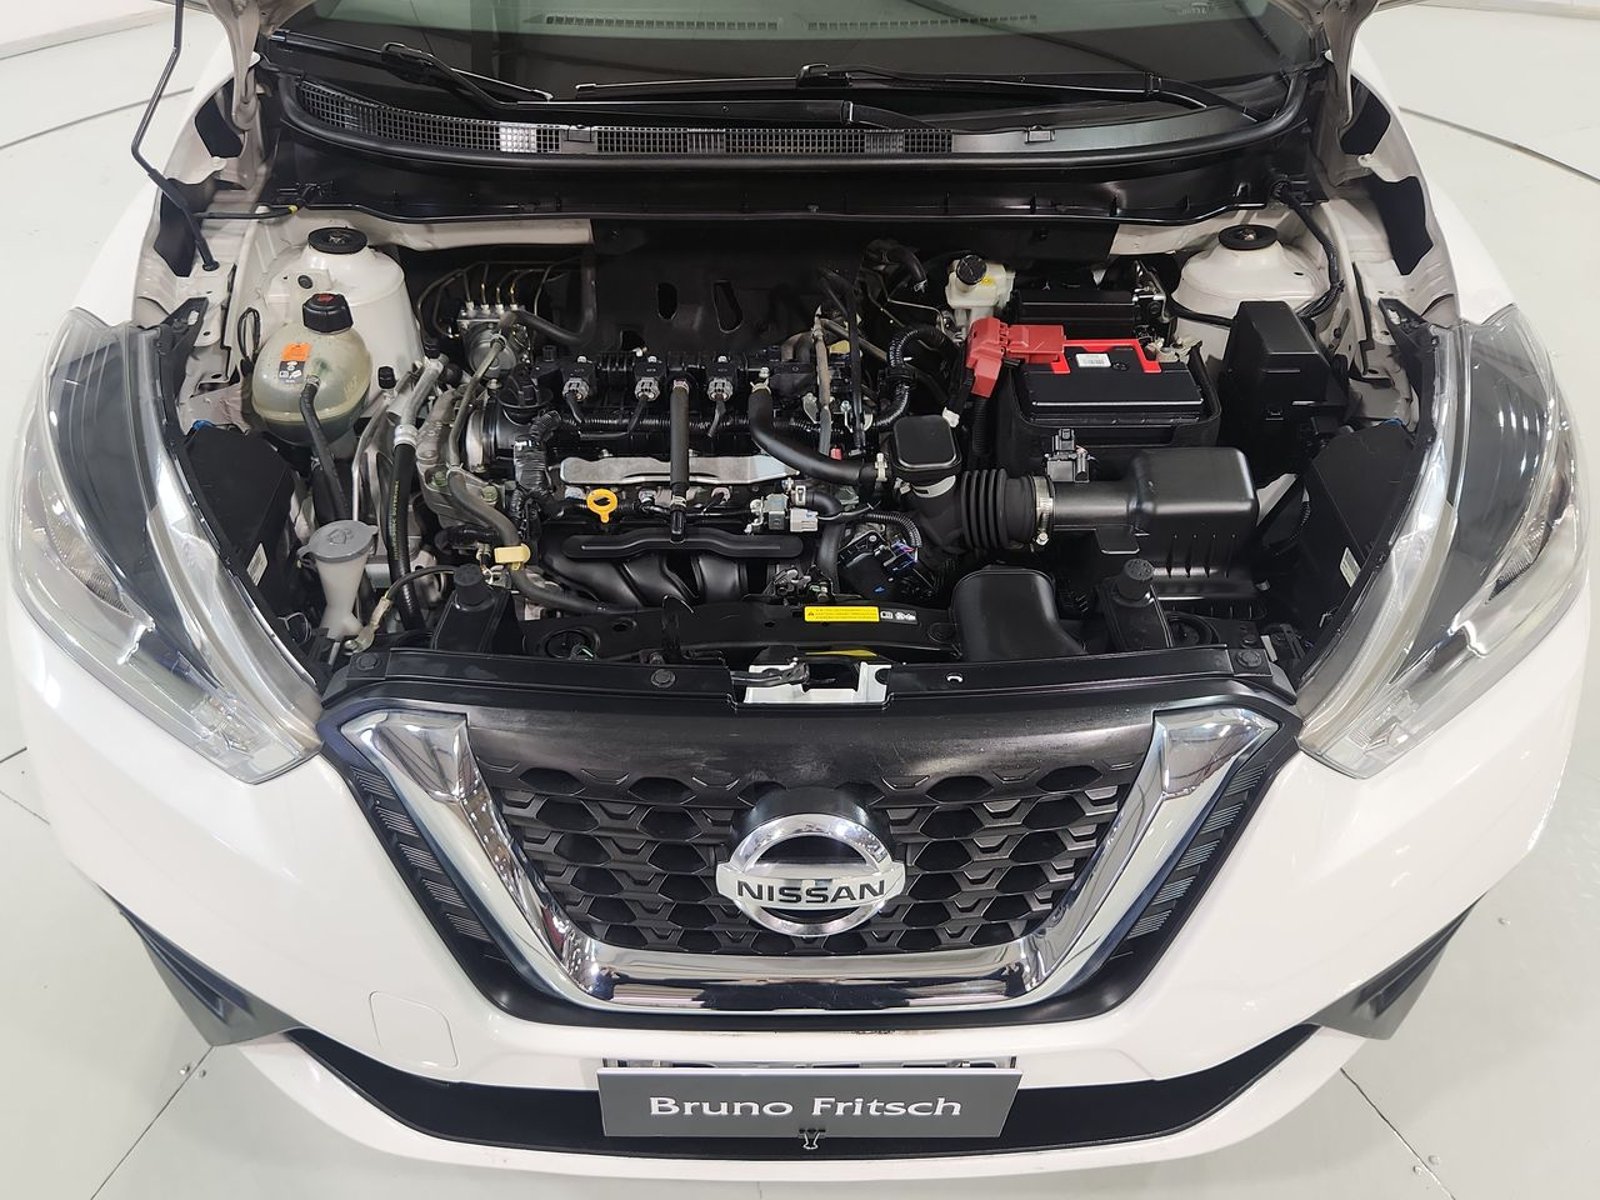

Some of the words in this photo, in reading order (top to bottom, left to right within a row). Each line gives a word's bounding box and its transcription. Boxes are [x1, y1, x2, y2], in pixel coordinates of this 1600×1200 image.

[737, 880, 885, 904] NISSAN
[649, 1096, 794, 1116] Bruno
[811, 1096, 962, 1116] Fritsch
